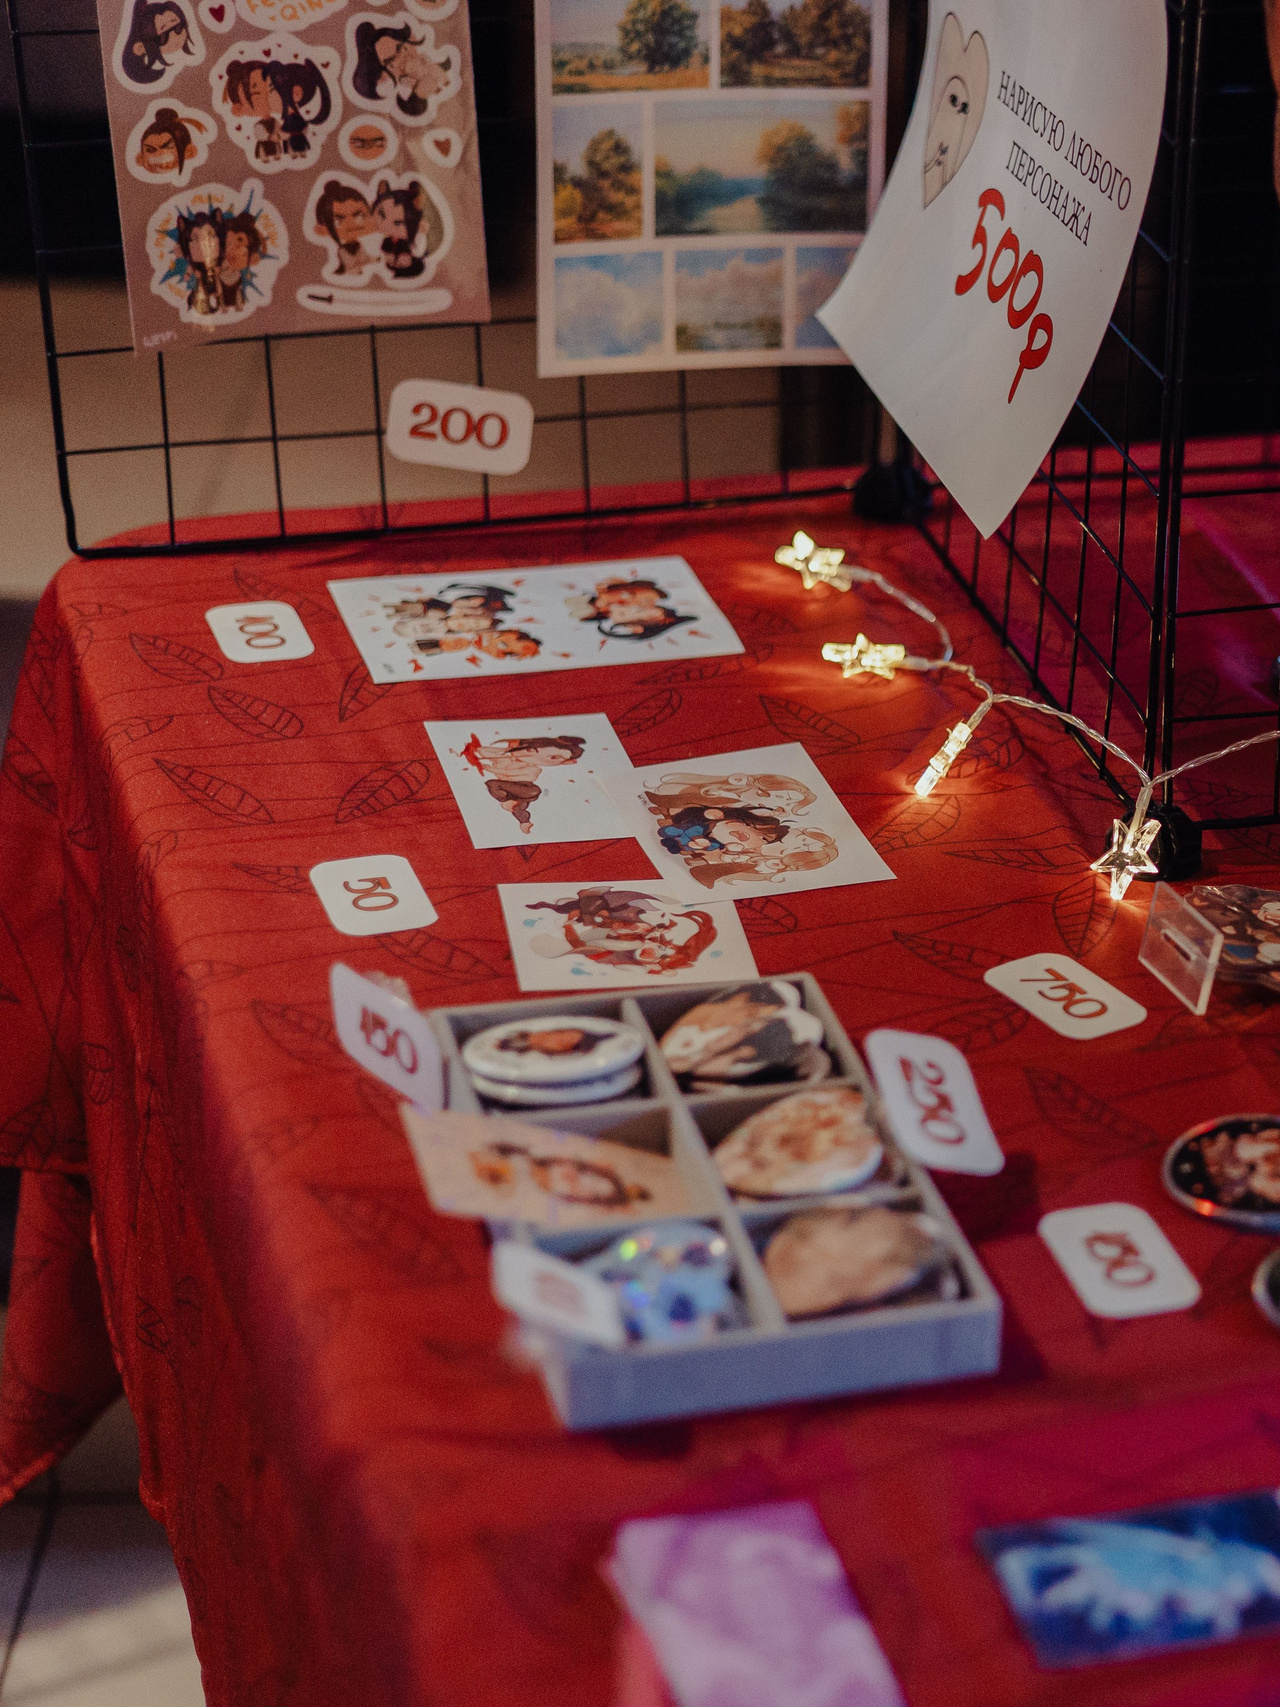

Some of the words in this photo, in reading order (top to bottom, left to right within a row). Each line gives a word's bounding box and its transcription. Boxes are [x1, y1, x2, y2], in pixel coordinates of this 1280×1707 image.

[997, 70, 1065, 152] НАРИСУЮ
[1064, 130, 1132, 211] ЛЮБОГО
[1005, 140, 1093, 247] ПЕРСОНАЖА
[408, 401, 509, 450] 200
[235, 615, 286, 650] 100
[342, 876, 399, 912] 50
[1019, 967, 1108, 1019] 750
[898, 1056, 968, 1146] 250
